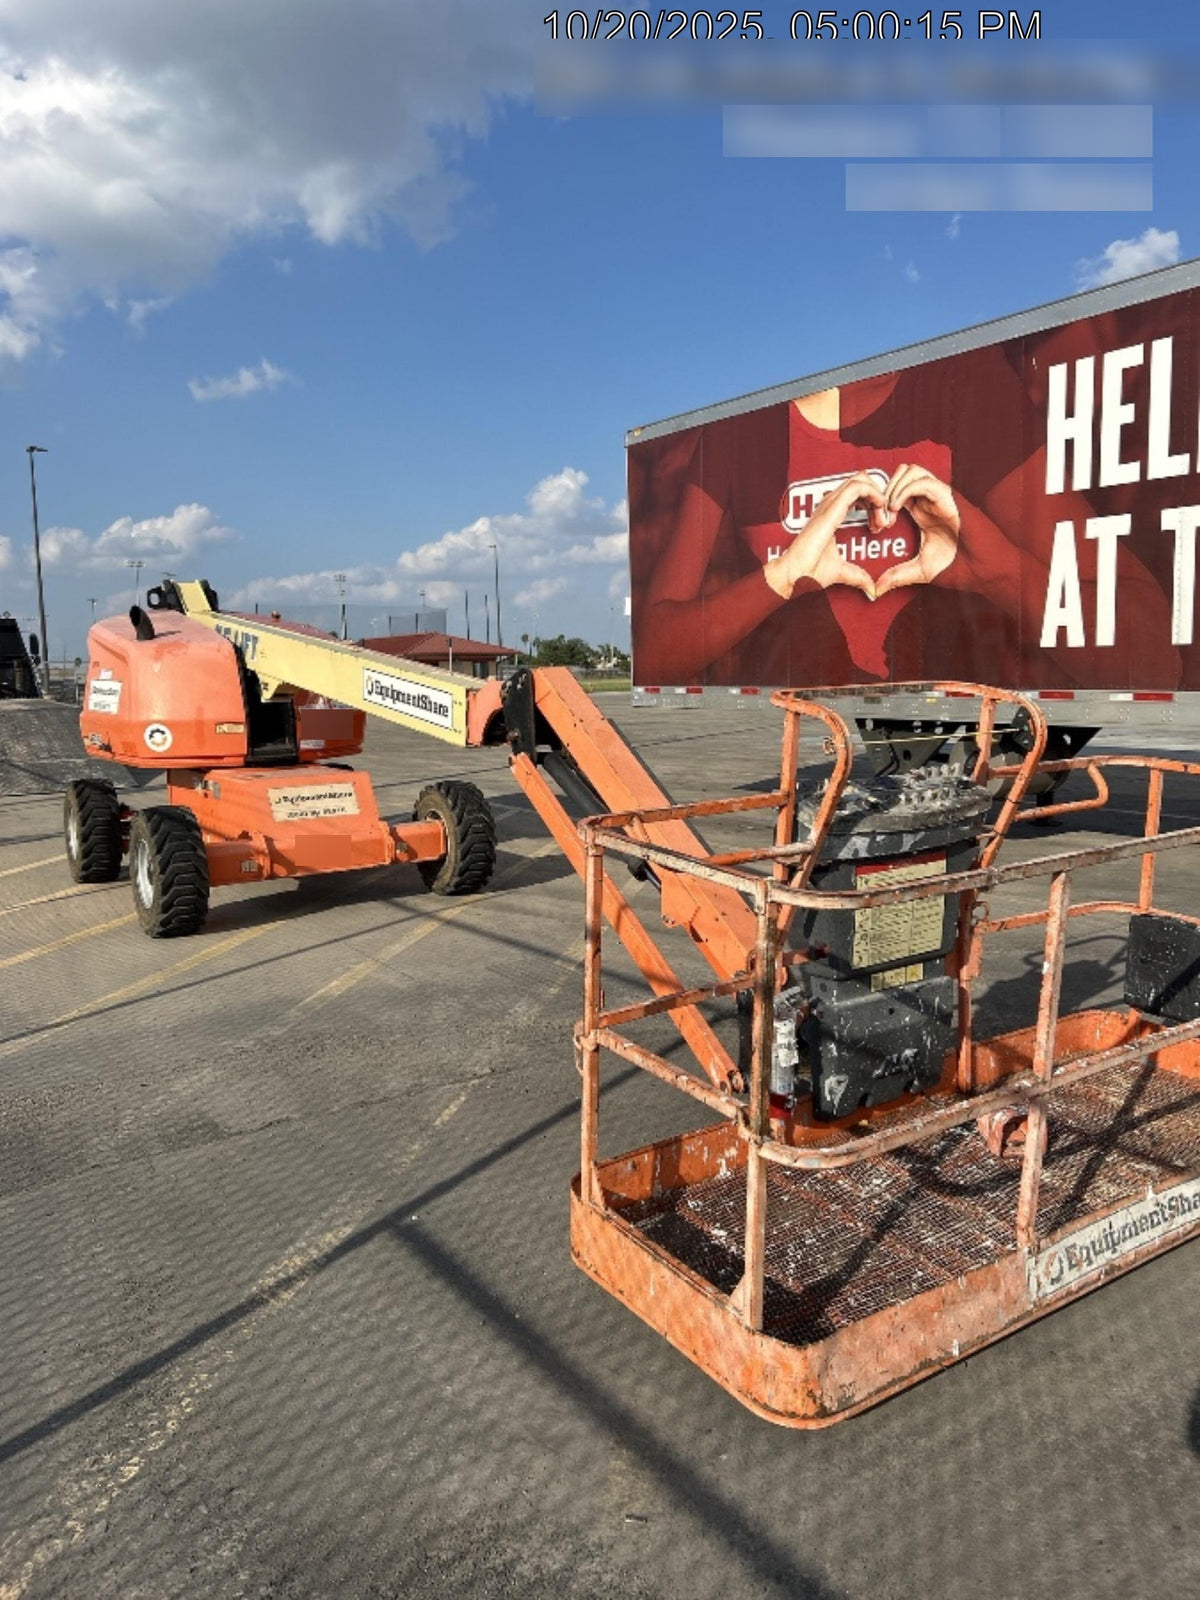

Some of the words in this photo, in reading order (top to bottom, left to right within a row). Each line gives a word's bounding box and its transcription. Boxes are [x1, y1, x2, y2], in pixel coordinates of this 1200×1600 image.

[1045, 335, 1200, 495] HEL
[1040, 513, 1132, 648] AT
[374, 679, 449, 719] EquipmentShare
